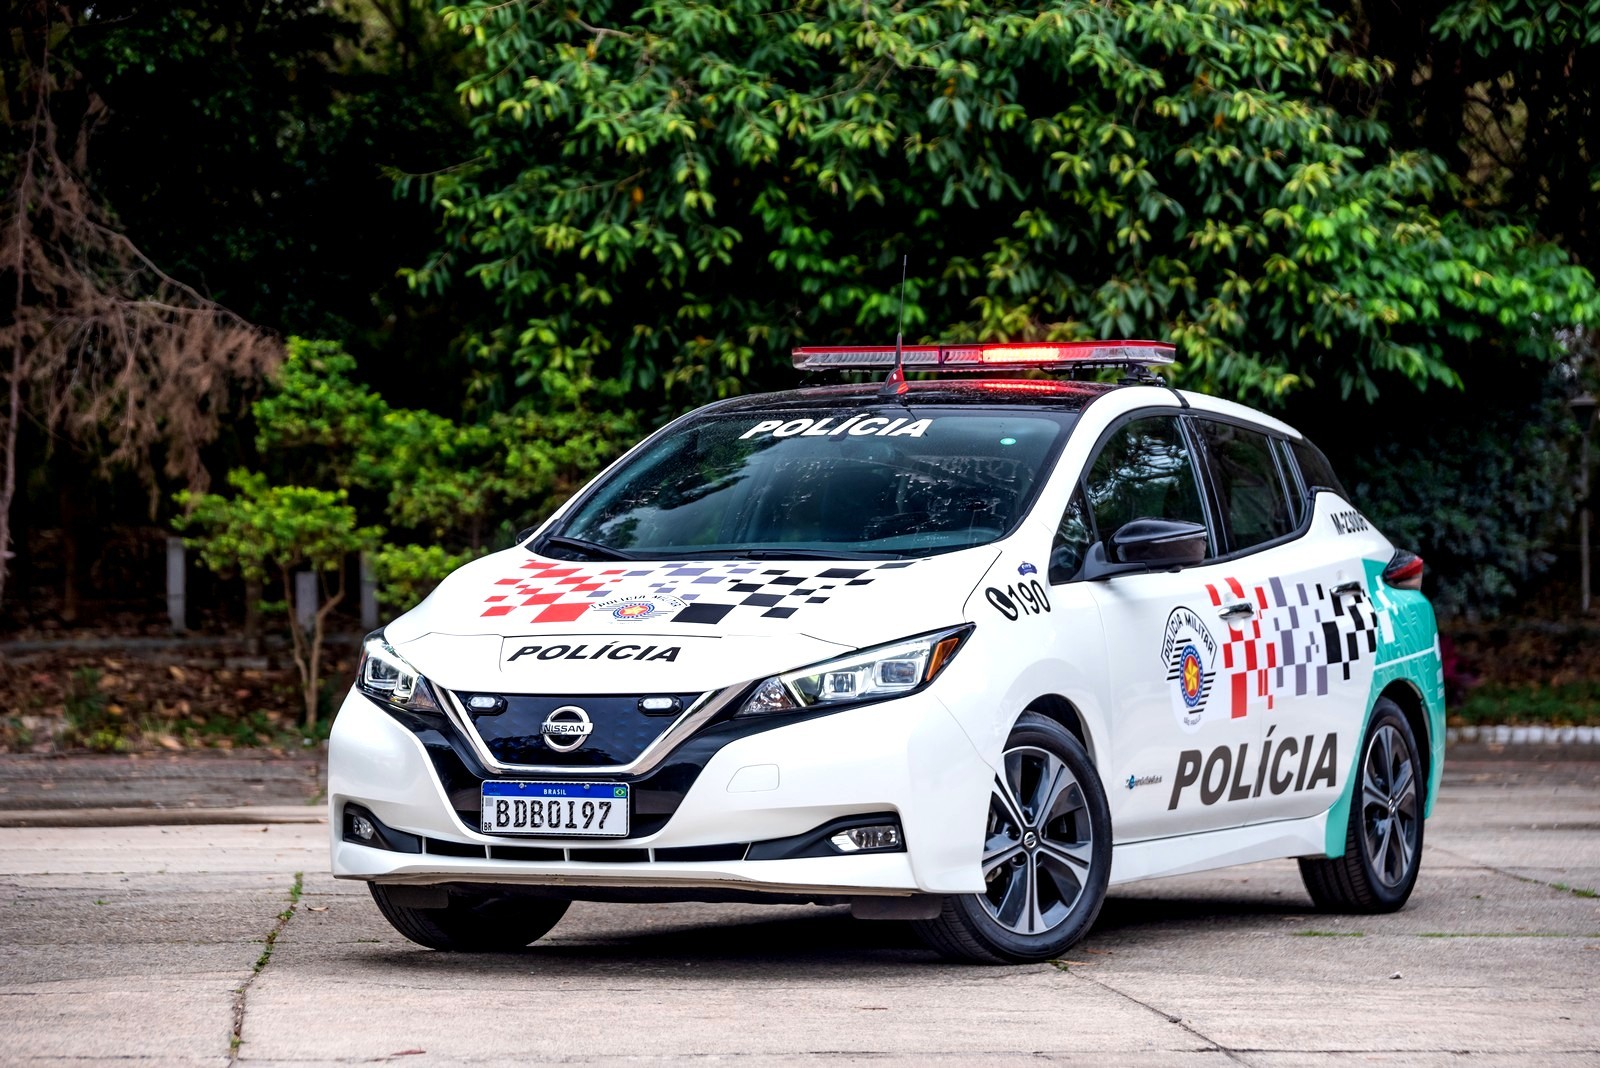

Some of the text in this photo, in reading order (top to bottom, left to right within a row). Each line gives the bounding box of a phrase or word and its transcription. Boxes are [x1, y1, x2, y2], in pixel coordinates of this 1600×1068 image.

[738, 414, 933, 440] POLÍCIA
[1007, 579, 1051, 616] 190
[1183, 611, 1214, 656] MILITAR
[507, 641, 682, 662] POLÍCIA
[543, 723, 585, 733] NISSAN
[1167, 724, 1338, 811] POLÍCIA
[543, 788, 567, 796] BRASIL
[483, 822, 492, 831] BR
